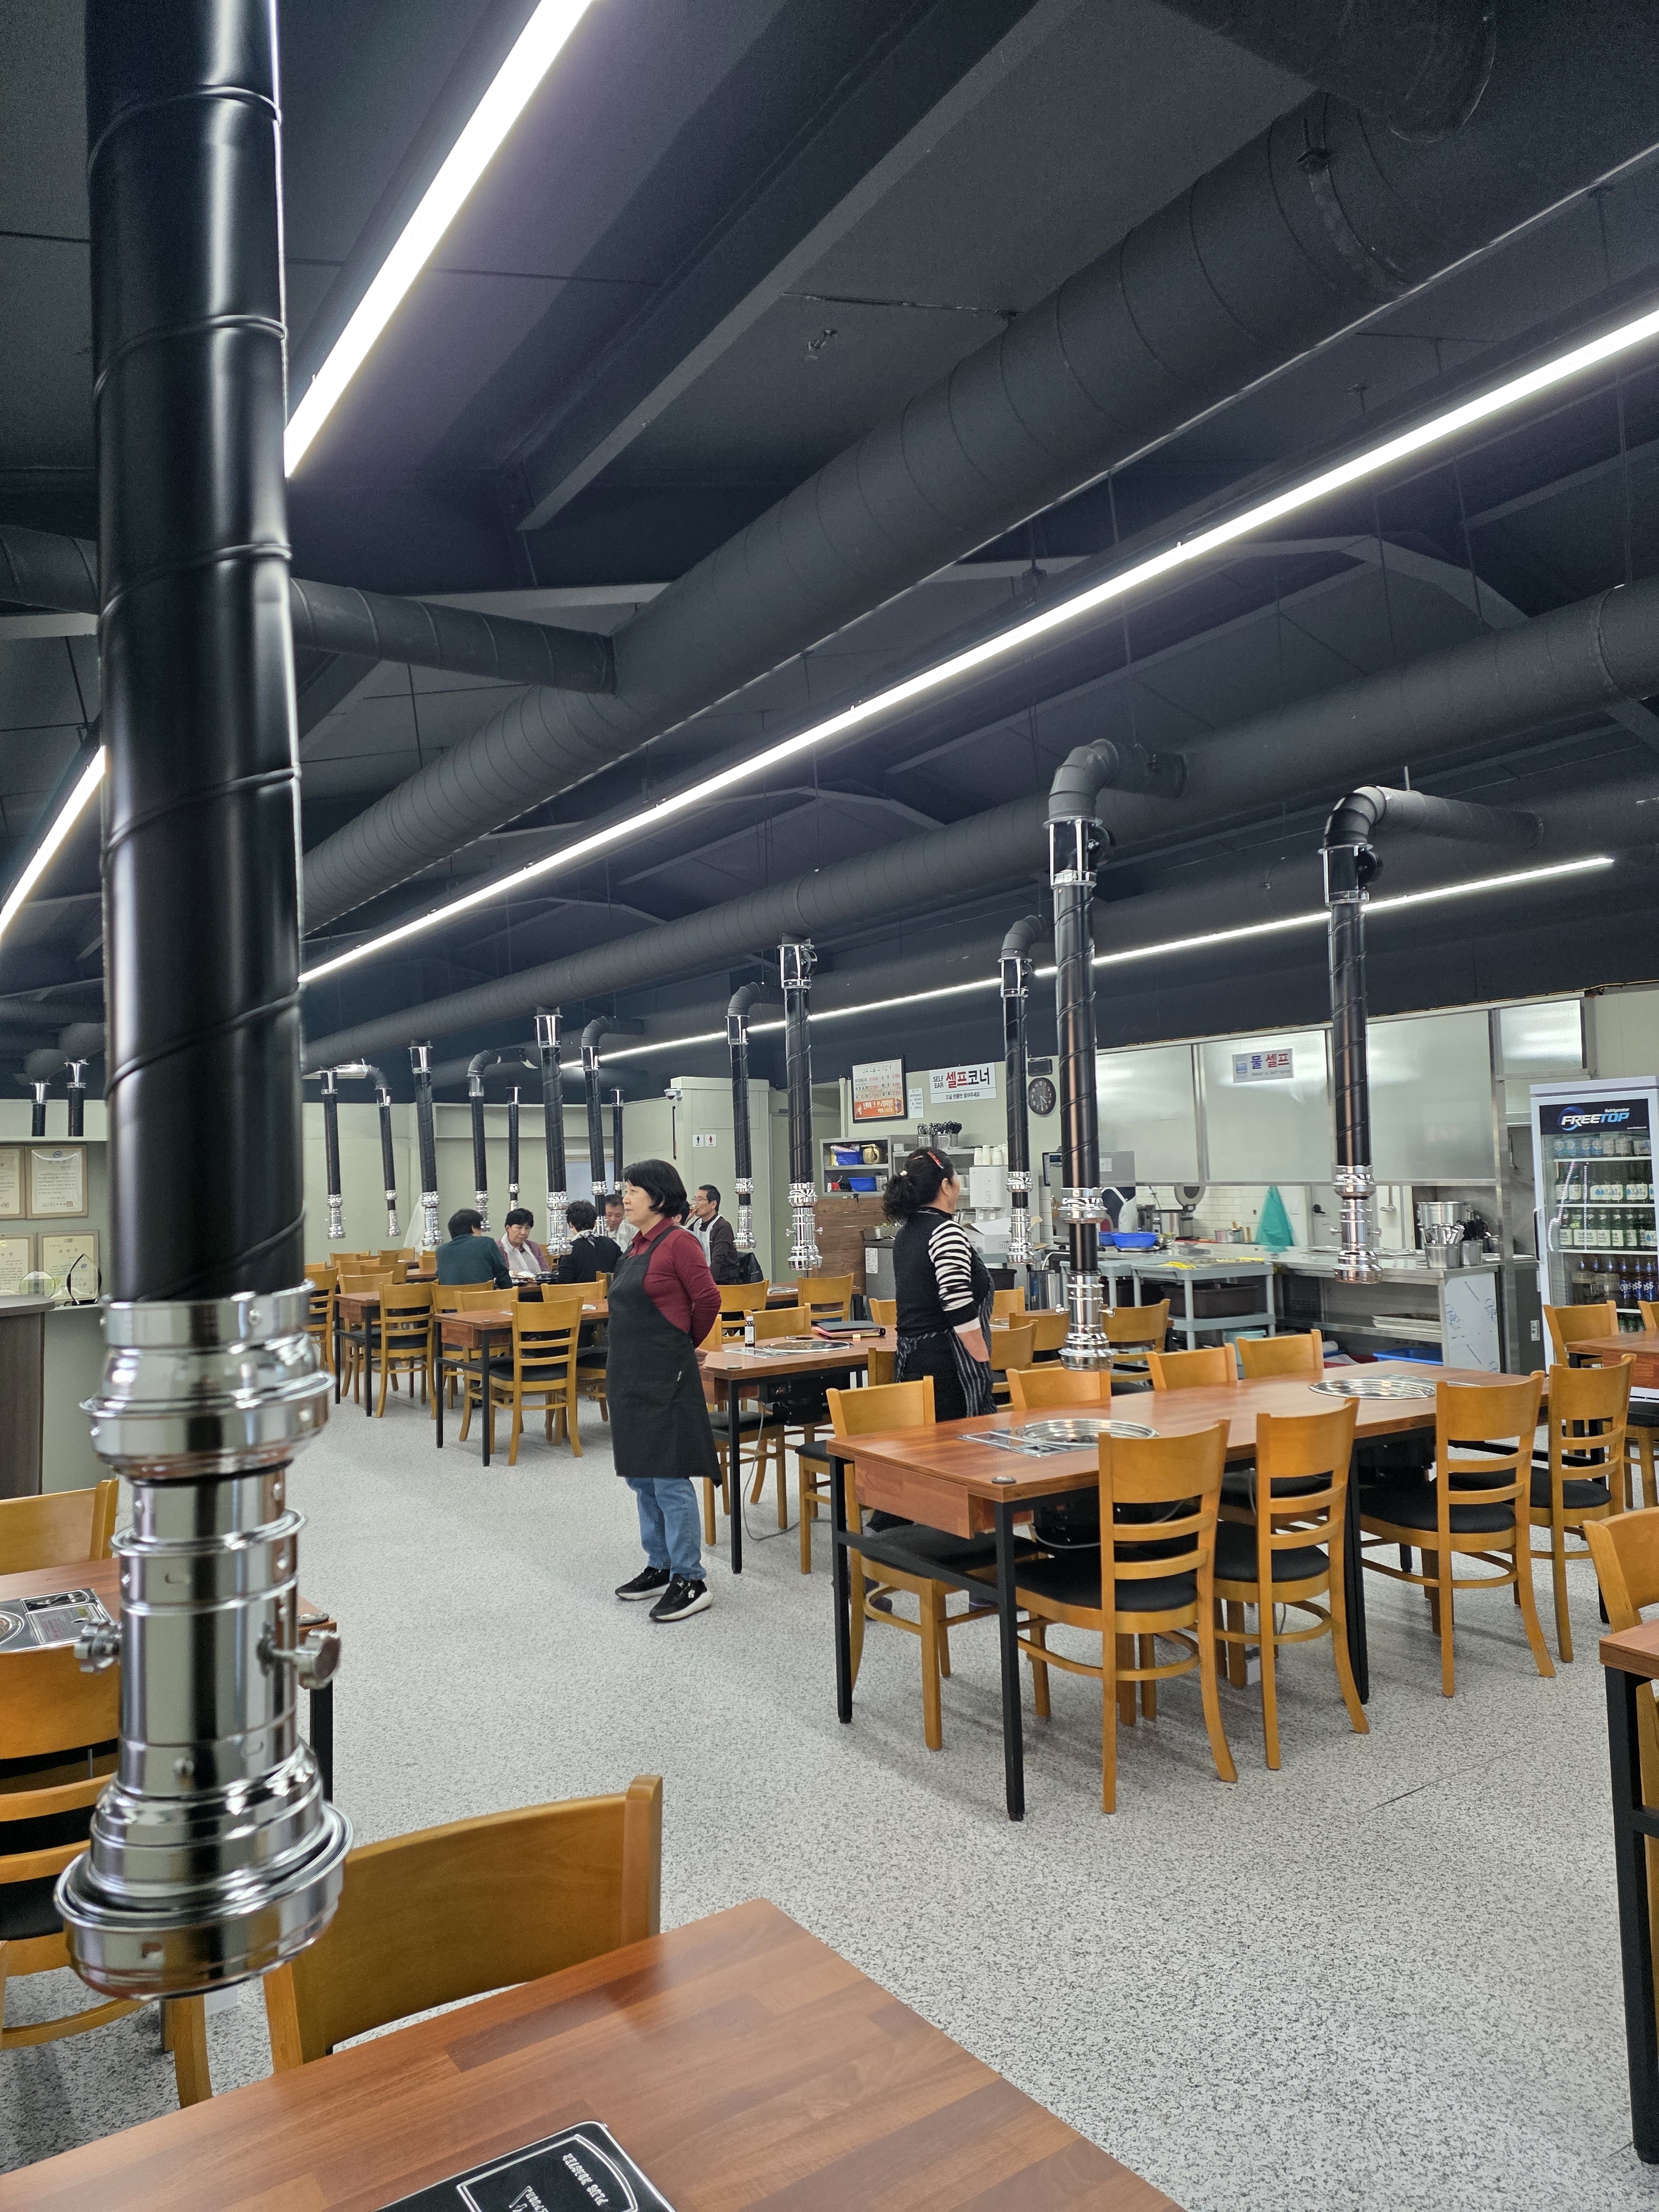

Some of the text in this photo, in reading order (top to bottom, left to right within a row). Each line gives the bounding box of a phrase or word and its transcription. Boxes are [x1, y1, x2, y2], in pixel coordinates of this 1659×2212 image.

[1251, 1053, 1290, 1070] 물 셀프
[946, 1067, 990, 1088] 셀프코너
[1561, 1112, 1630, 1126] FREETOP
[586, 2184, 609, 2206] PLUS
